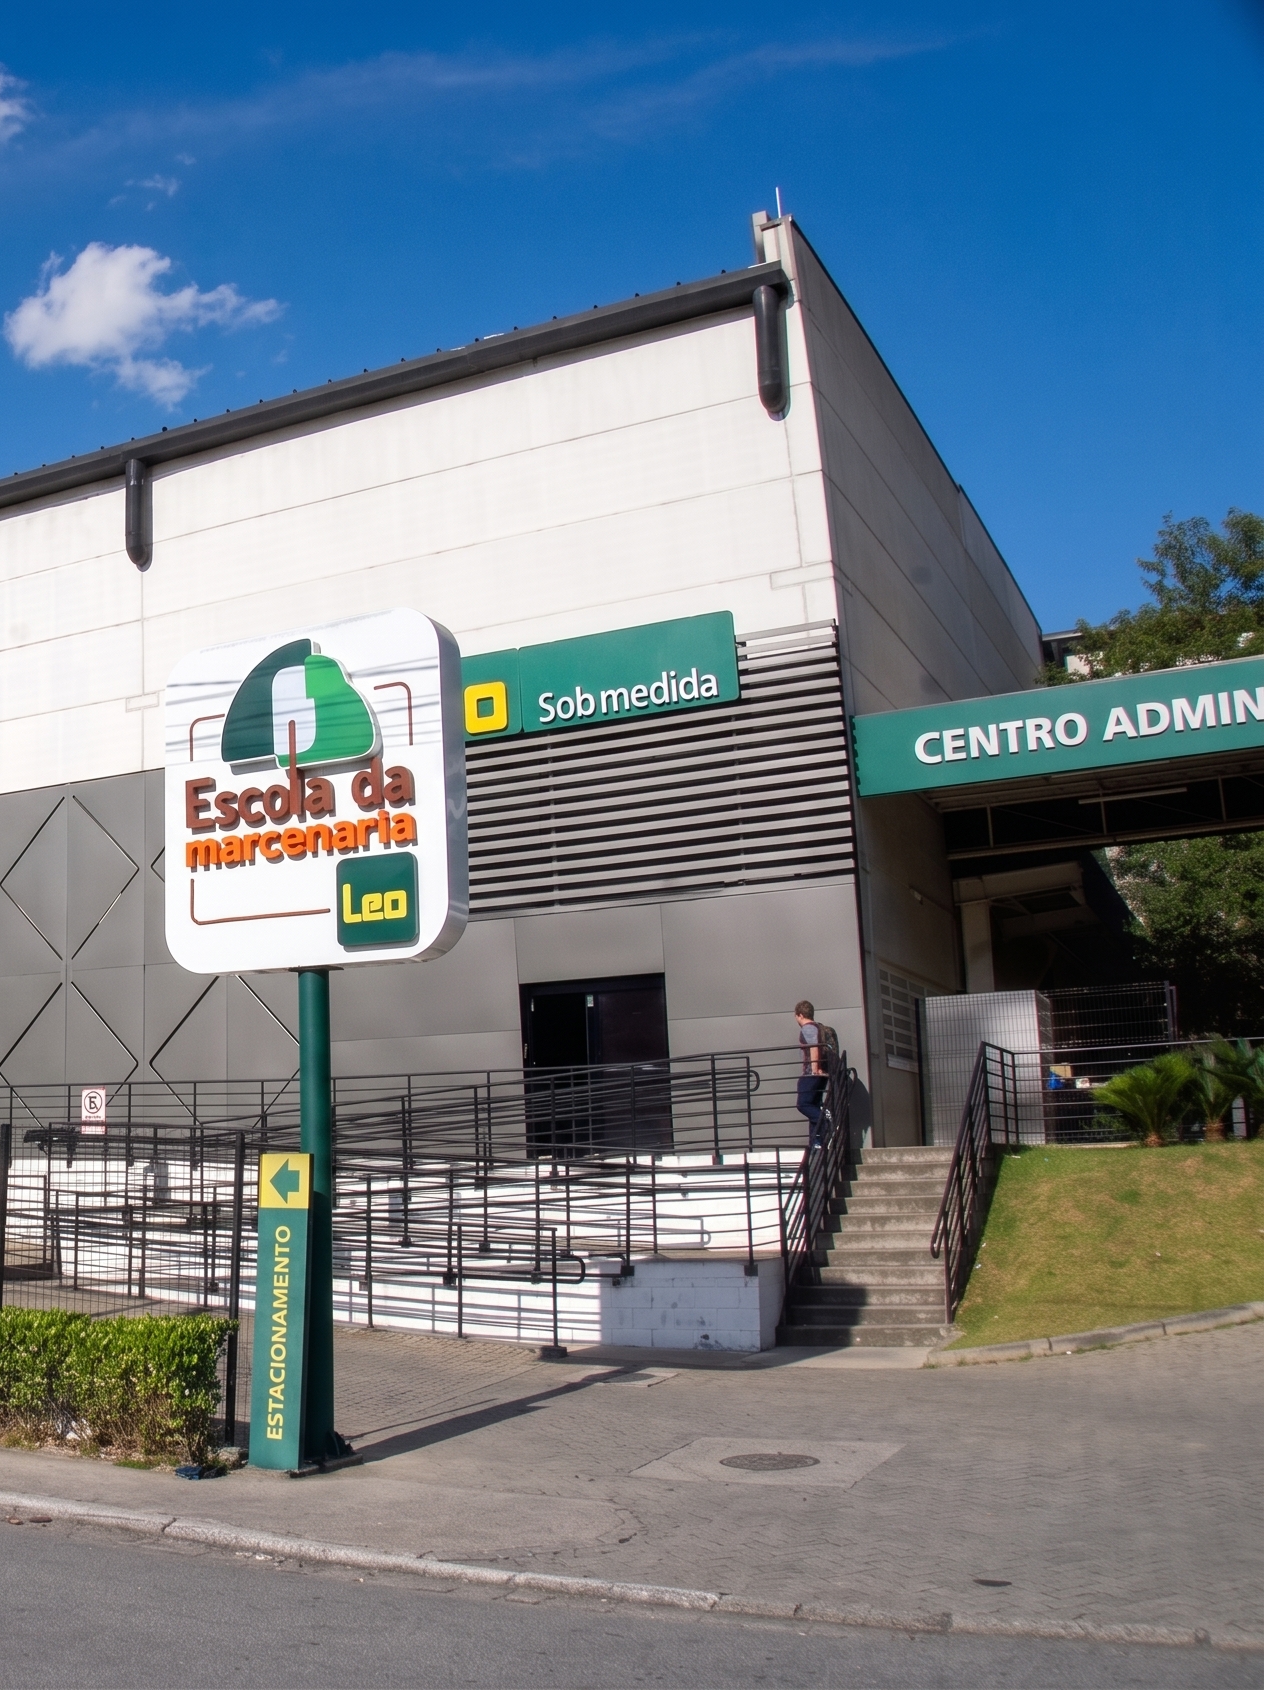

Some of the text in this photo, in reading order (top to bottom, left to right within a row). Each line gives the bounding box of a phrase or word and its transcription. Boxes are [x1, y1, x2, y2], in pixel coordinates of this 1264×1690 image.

[914, 713, 1087, 764] CENTRO
[185, 759, 415, 831] Escola da
[185, 810, 416, 869] marcenaria
[342, 883, 407, 924] Leo
[266, 1225, 291, 1441] ESTACIONAMENTO
